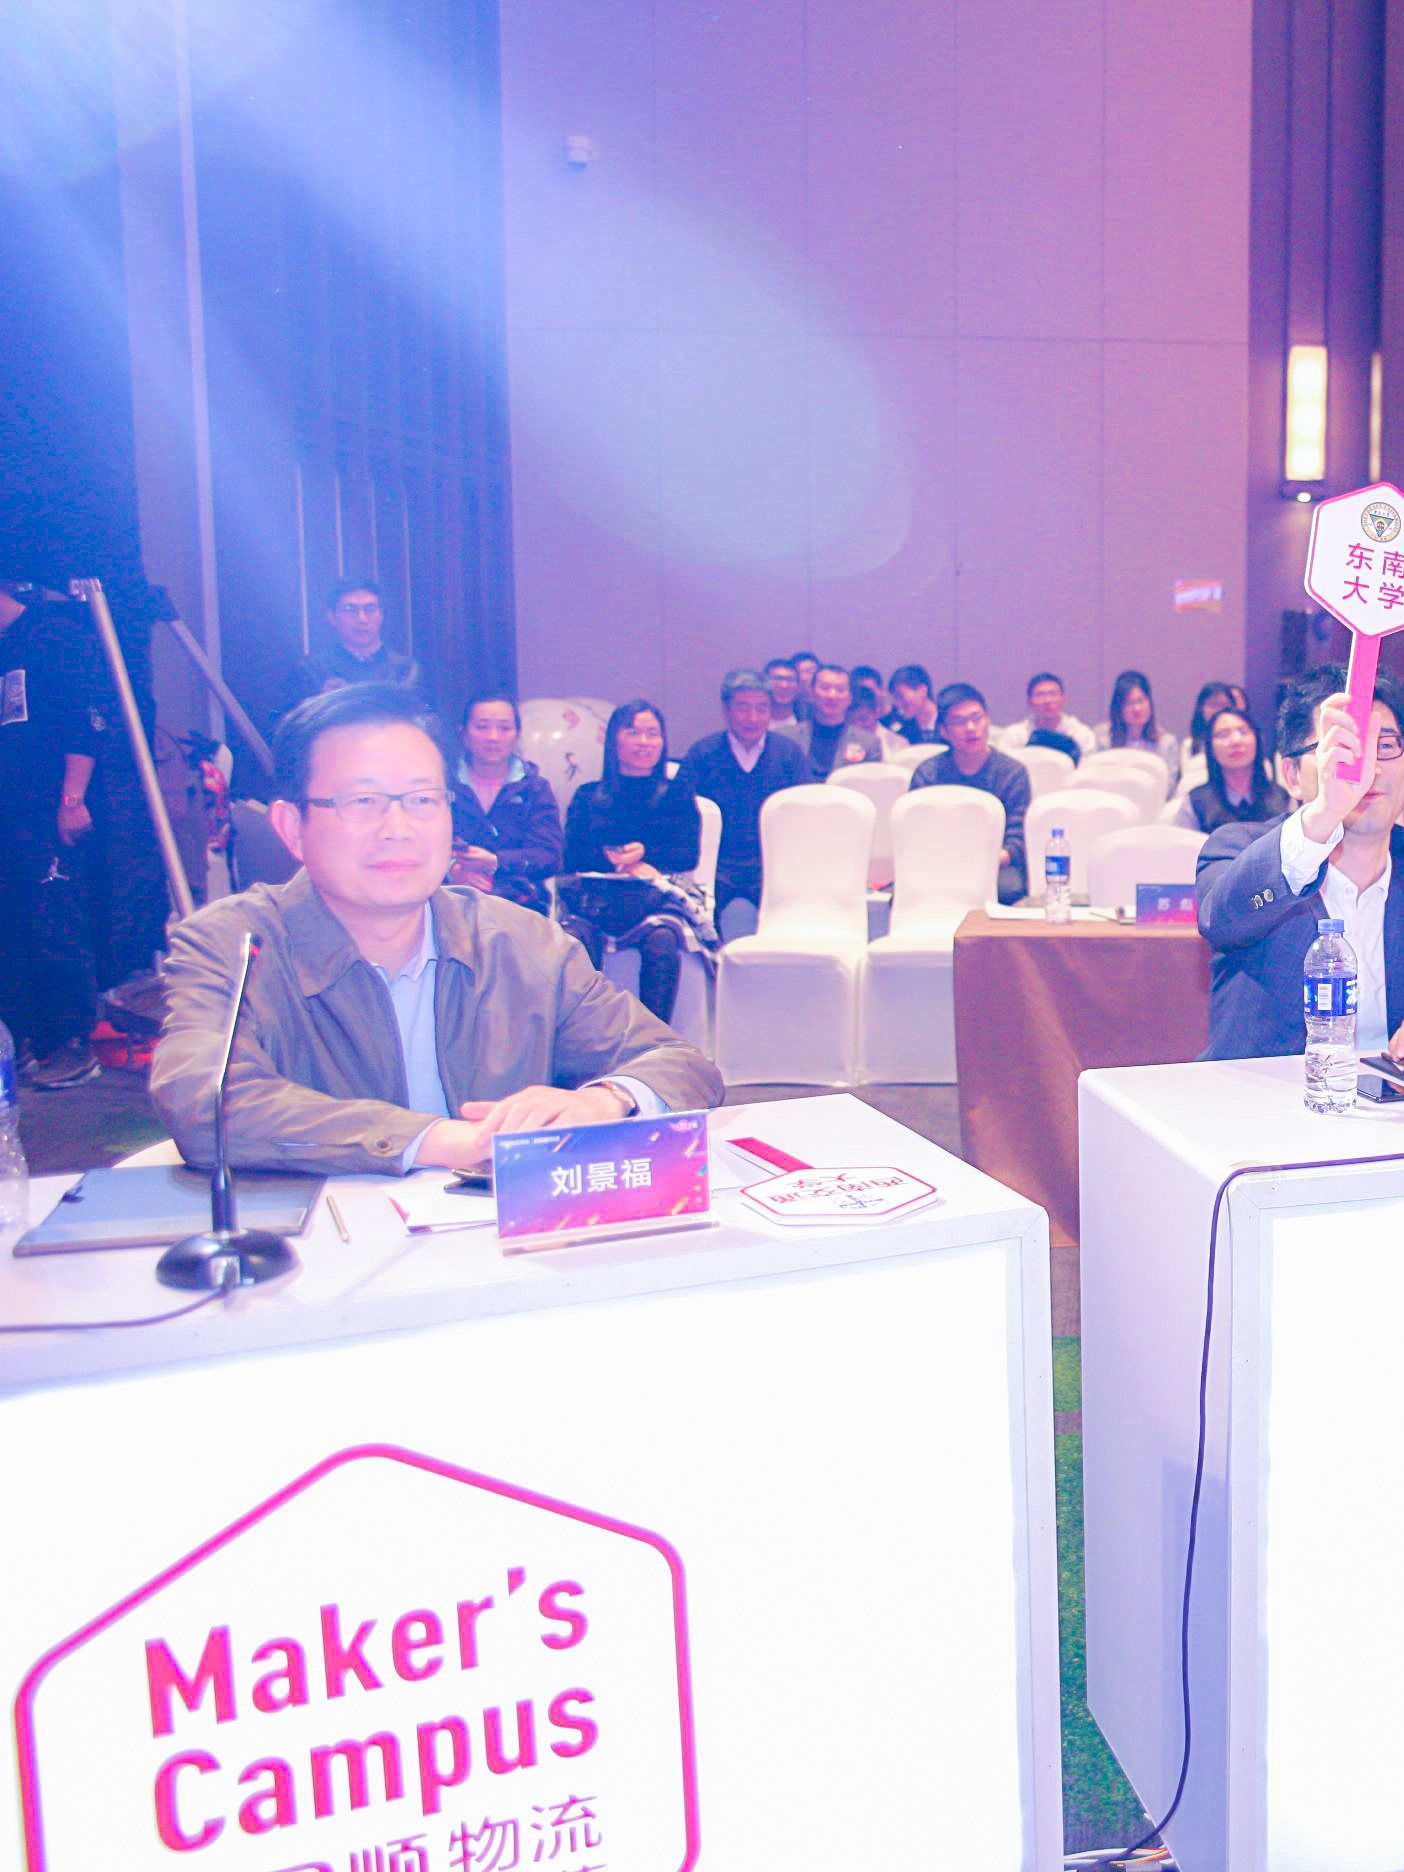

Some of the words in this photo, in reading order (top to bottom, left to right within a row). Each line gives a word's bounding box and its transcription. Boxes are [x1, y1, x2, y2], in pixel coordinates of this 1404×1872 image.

[1342, 576, 1404, 610] 大学
[551, 1158, 652, 1197] 刘景福
[144, 1566, 589, 1740] Maker's
[154, 1687, 599, 1853] Campus
